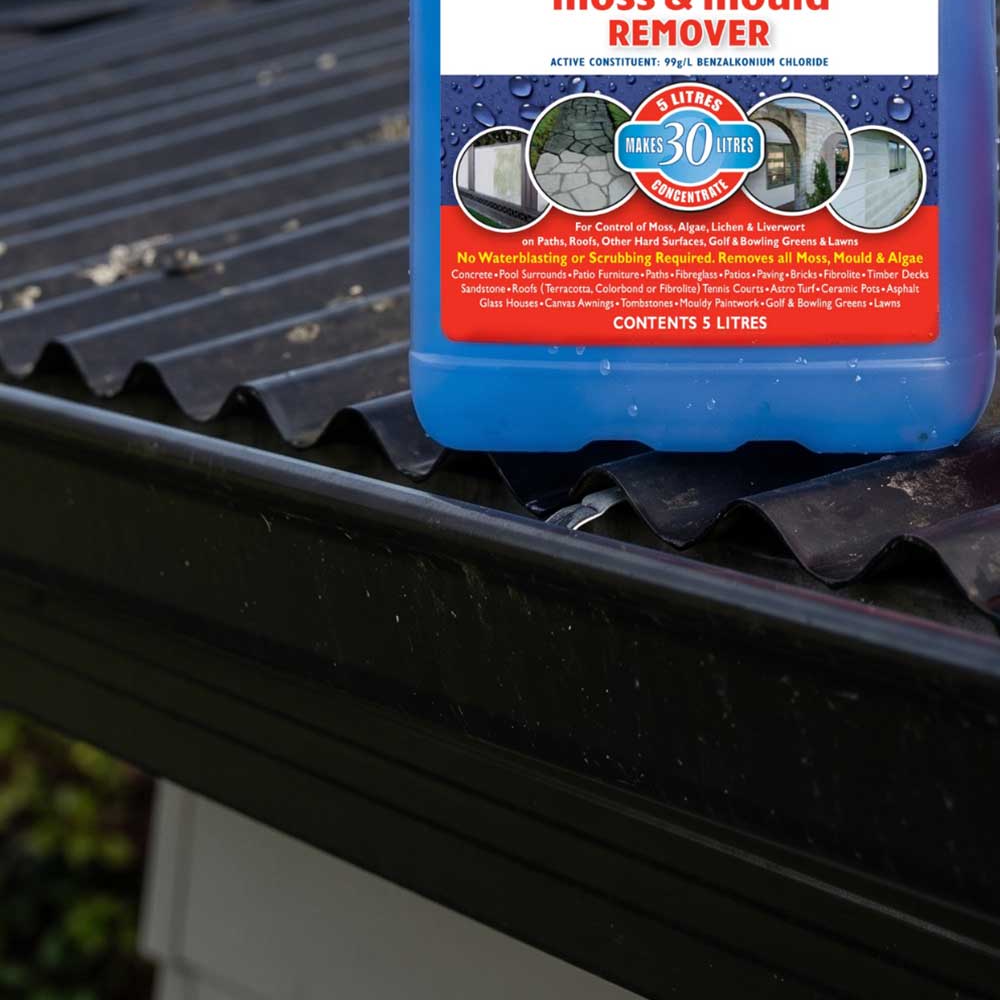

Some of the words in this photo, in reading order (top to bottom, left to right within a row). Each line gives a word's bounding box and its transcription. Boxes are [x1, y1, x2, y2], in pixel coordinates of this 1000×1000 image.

[609, 19, 769, 46] REMOVER
[551, 57, 585, 67] ACTIVE
[589, 57, 661, 67] CONSTITUENT:
[664, 57, 693, 69] 99g/L
[697, 57, 775, 67] BENZALKONIUM
[779, 57, 829, 67] CHLORIDE
[656, 98, 668, 111] 5
[670, 91, 723, 111] LITRES
[626, 138, 663, 152] MAKES
[658, 122, 713, 166] 30
[717, 137, 753, 152] LITRES
[651, 179, 728, 202] CONCENTRATE
[575, 223, 592, 232] For
[595, 223, 633, 232] Control
[636, 223, 646, 232] of
[649, 223, 676, 233] Moss,
[679, 223, 709, 234] Algae,
[712, 223, 743, 232] Lichen
[747, 223, 753, 232] &
[757, 223, 805, 232] Liverwort
[538, 237, 567, 247] Paths,
[569, 237, 599, 247] Roofs,
[602, 237, 632, 246] Other
[635, 237, 658, 246] Hard
[663, 237, 706, 247] Surfaces,
[709, 237, 729, 246] Golf
[732, 237, 739, 246] &
[741, 237, 779, 248] Bowling
[782, 237, 817, 246] Greens
[820, 237, 826, 246] &
[828, 237, 858, 246] Lawns
[457, 252, 475, 264] No
[479, 252, 567, 266] Waterblasting
[572, 255, 585, 264] or
[589, 252, 651, 266] Scrubbing
[656, 252, 715, 266] Required.
[719, 252, 774, 264] Removes
[778, 252, 792, 264] all
[797, 252, 830, 265] Moss,
[834, 252, 872, 264] Mould
[876, 252, 884, 264] &
[888, 252, 923, 266] Algae
[613, 316, 697, 329] CONTENTS
[702, 316, 710, 329] 5
[717, 316, 767, 329] LITRES
